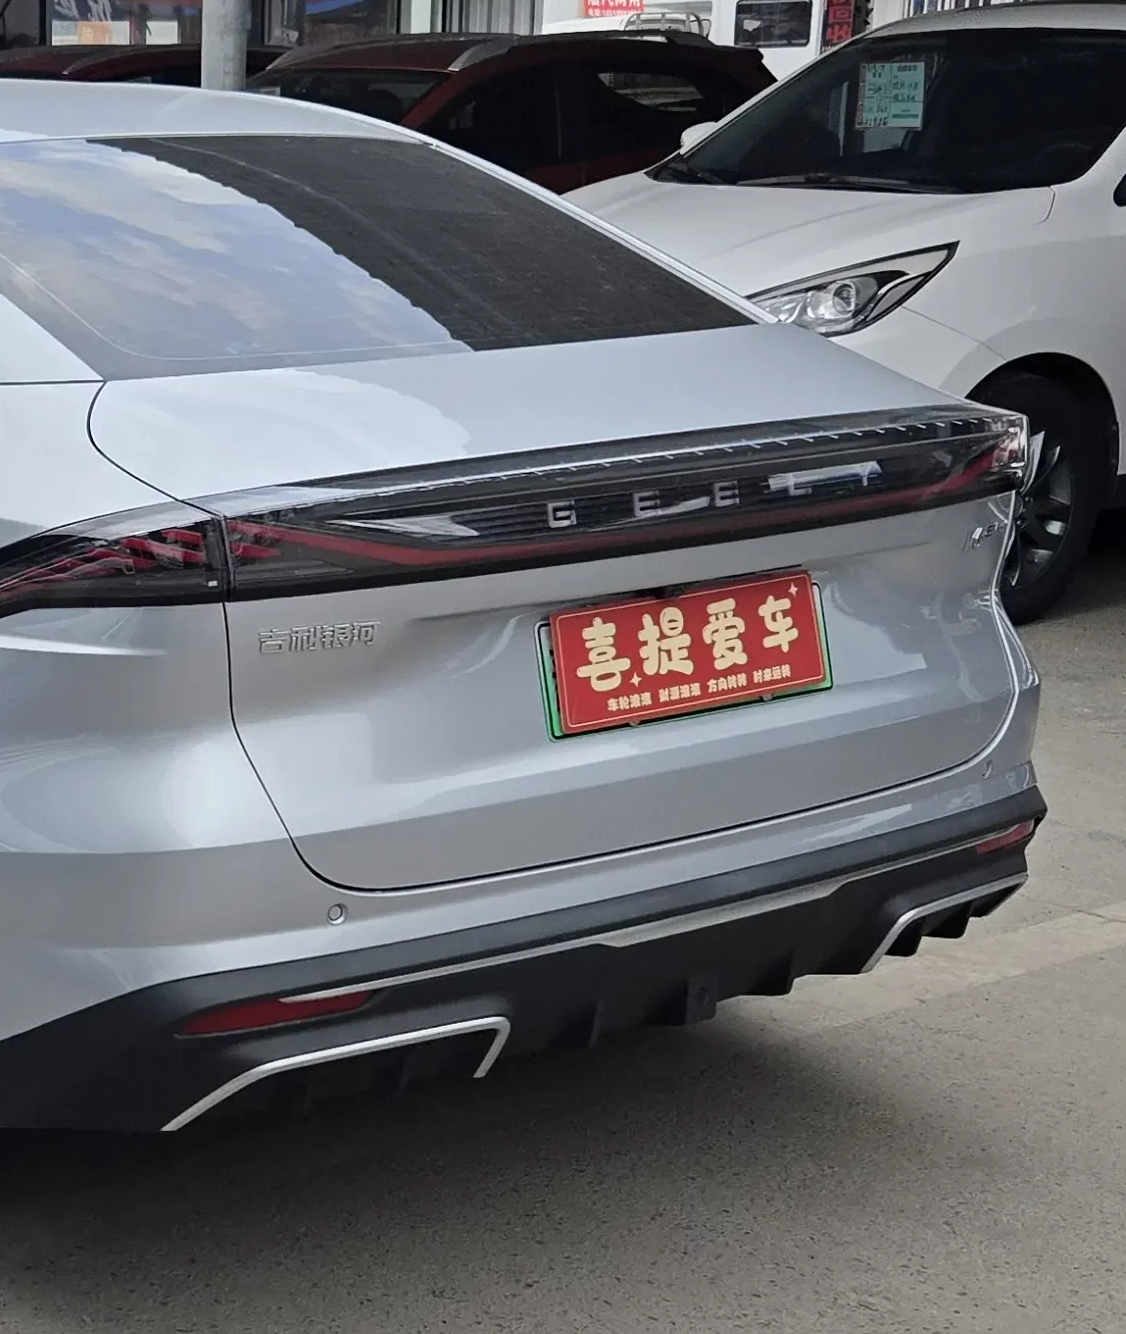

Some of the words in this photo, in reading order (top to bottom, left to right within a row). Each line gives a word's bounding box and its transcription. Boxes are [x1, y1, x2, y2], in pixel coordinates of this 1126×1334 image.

[546, 461, 882, 529] GEELY
[258, 620, 381, 654] 吉利银河
[577, 598, 801, 692] 喜提爱车
[607, 692, 652, 712] 车轮滚滚
[753, 664, 791, 683] 时来运转
